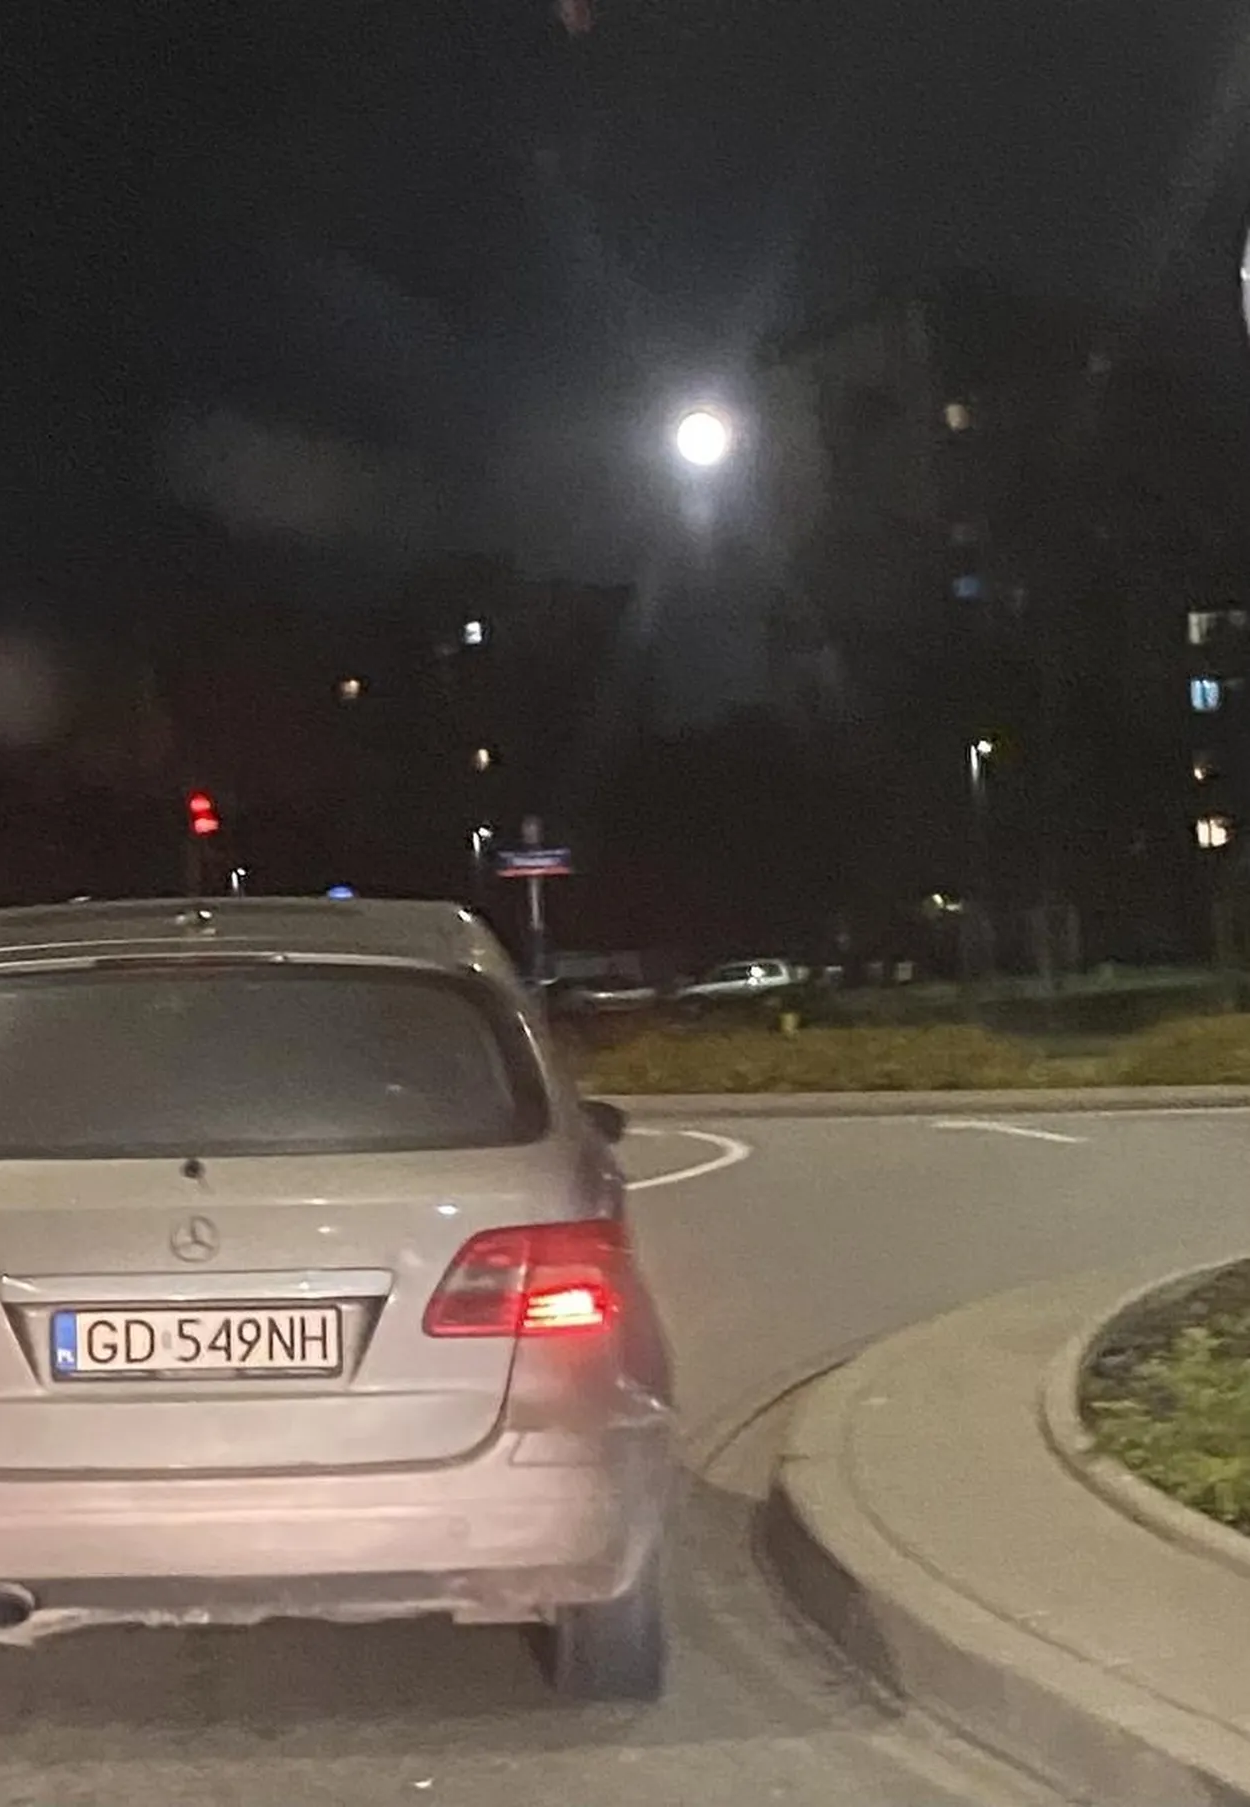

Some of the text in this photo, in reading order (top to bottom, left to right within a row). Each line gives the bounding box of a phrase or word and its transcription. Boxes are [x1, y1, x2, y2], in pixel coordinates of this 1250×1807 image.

[86, 1316, 328, 1364] GD 549NH
[57, 1349, 75, 1363] PL
